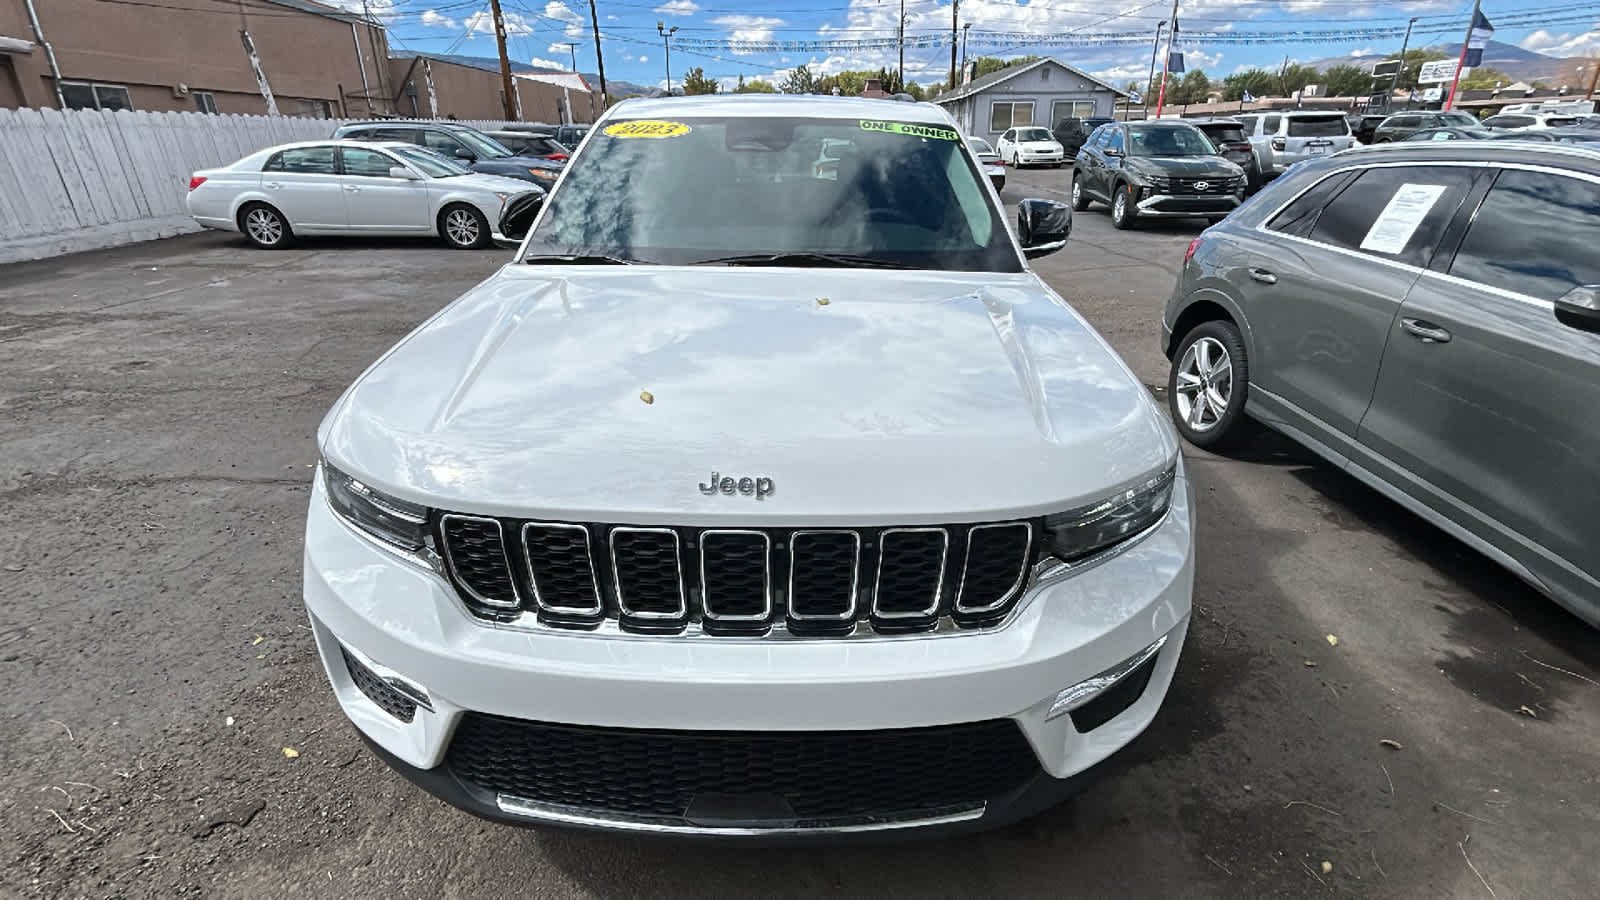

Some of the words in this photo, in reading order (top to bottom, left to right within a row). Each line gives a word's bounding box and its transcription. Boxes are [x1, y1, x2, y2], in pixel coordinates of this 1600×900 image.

[862, 121, 893, 131] ONE
[901, 125, 955, 140] OWNER
[698, 471, 776, 501] Jeep
